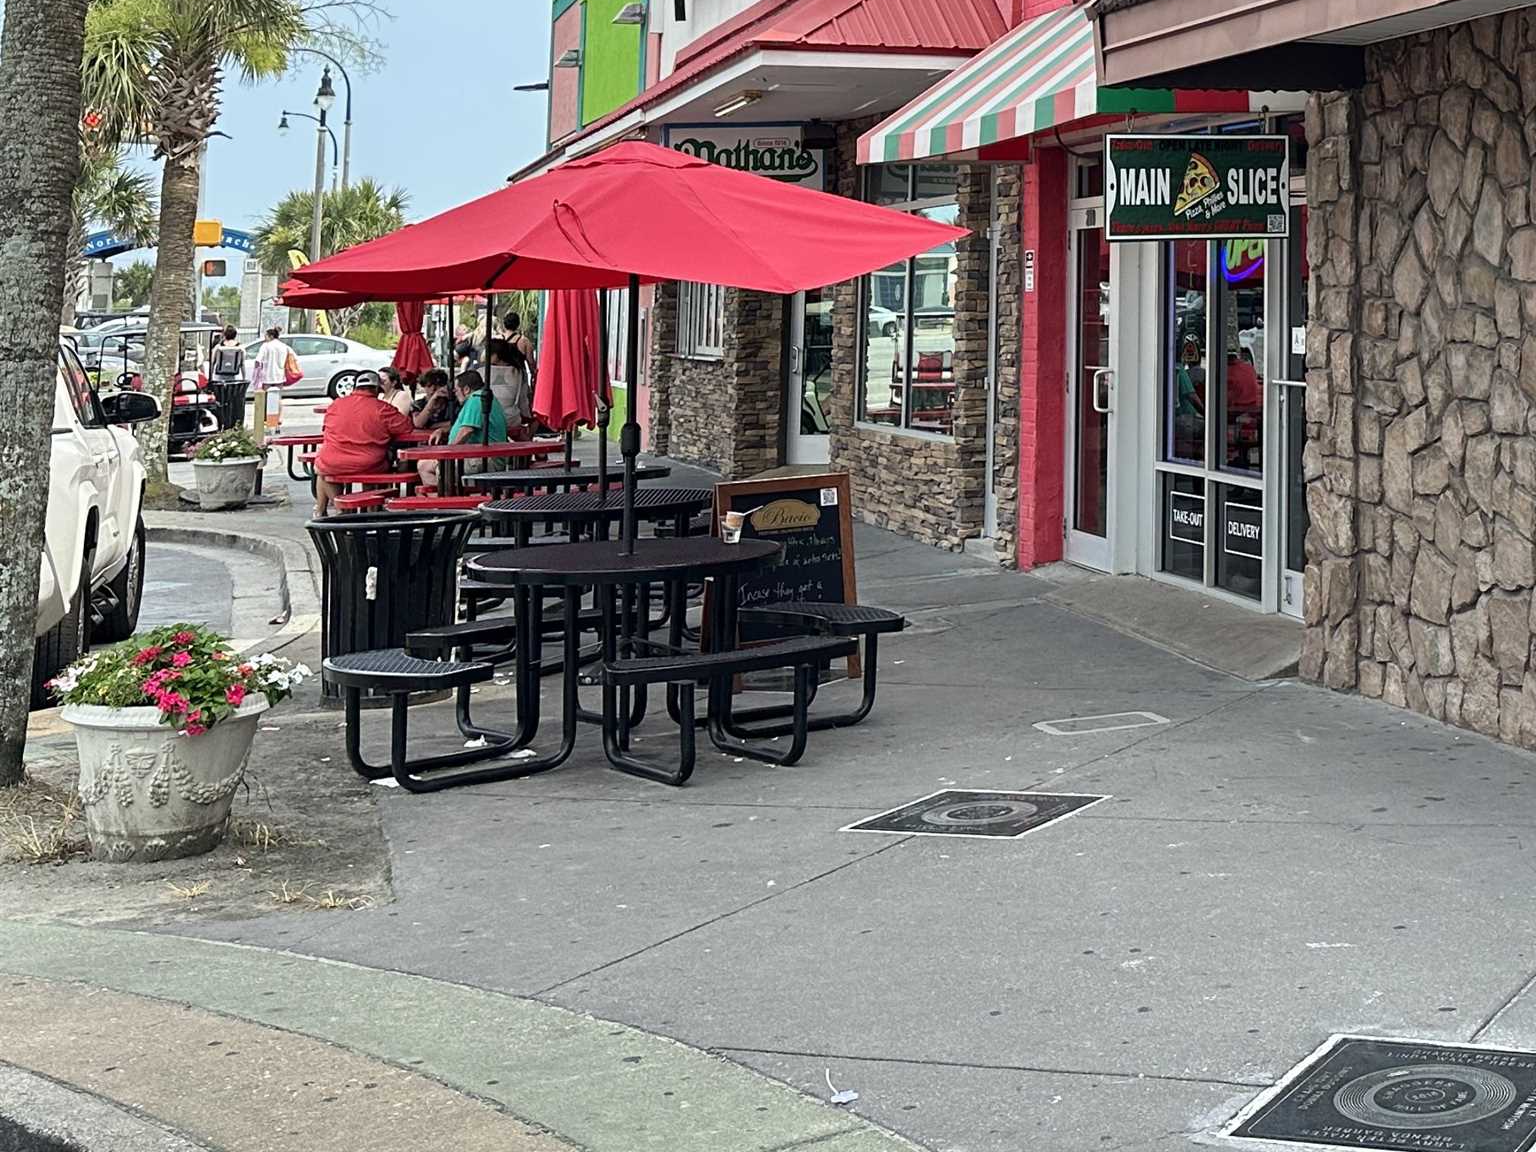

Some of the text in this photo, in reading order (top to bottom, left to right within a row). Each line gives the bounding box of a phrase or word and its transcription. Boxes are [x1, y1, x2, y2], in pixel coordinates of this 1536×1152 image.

[1120, 168, 1277, 206] MAIN SLICE
[1173, 509, 1203, 527] TAKE-OUT
[1228, 521, 1260, 540] DELIVERY
